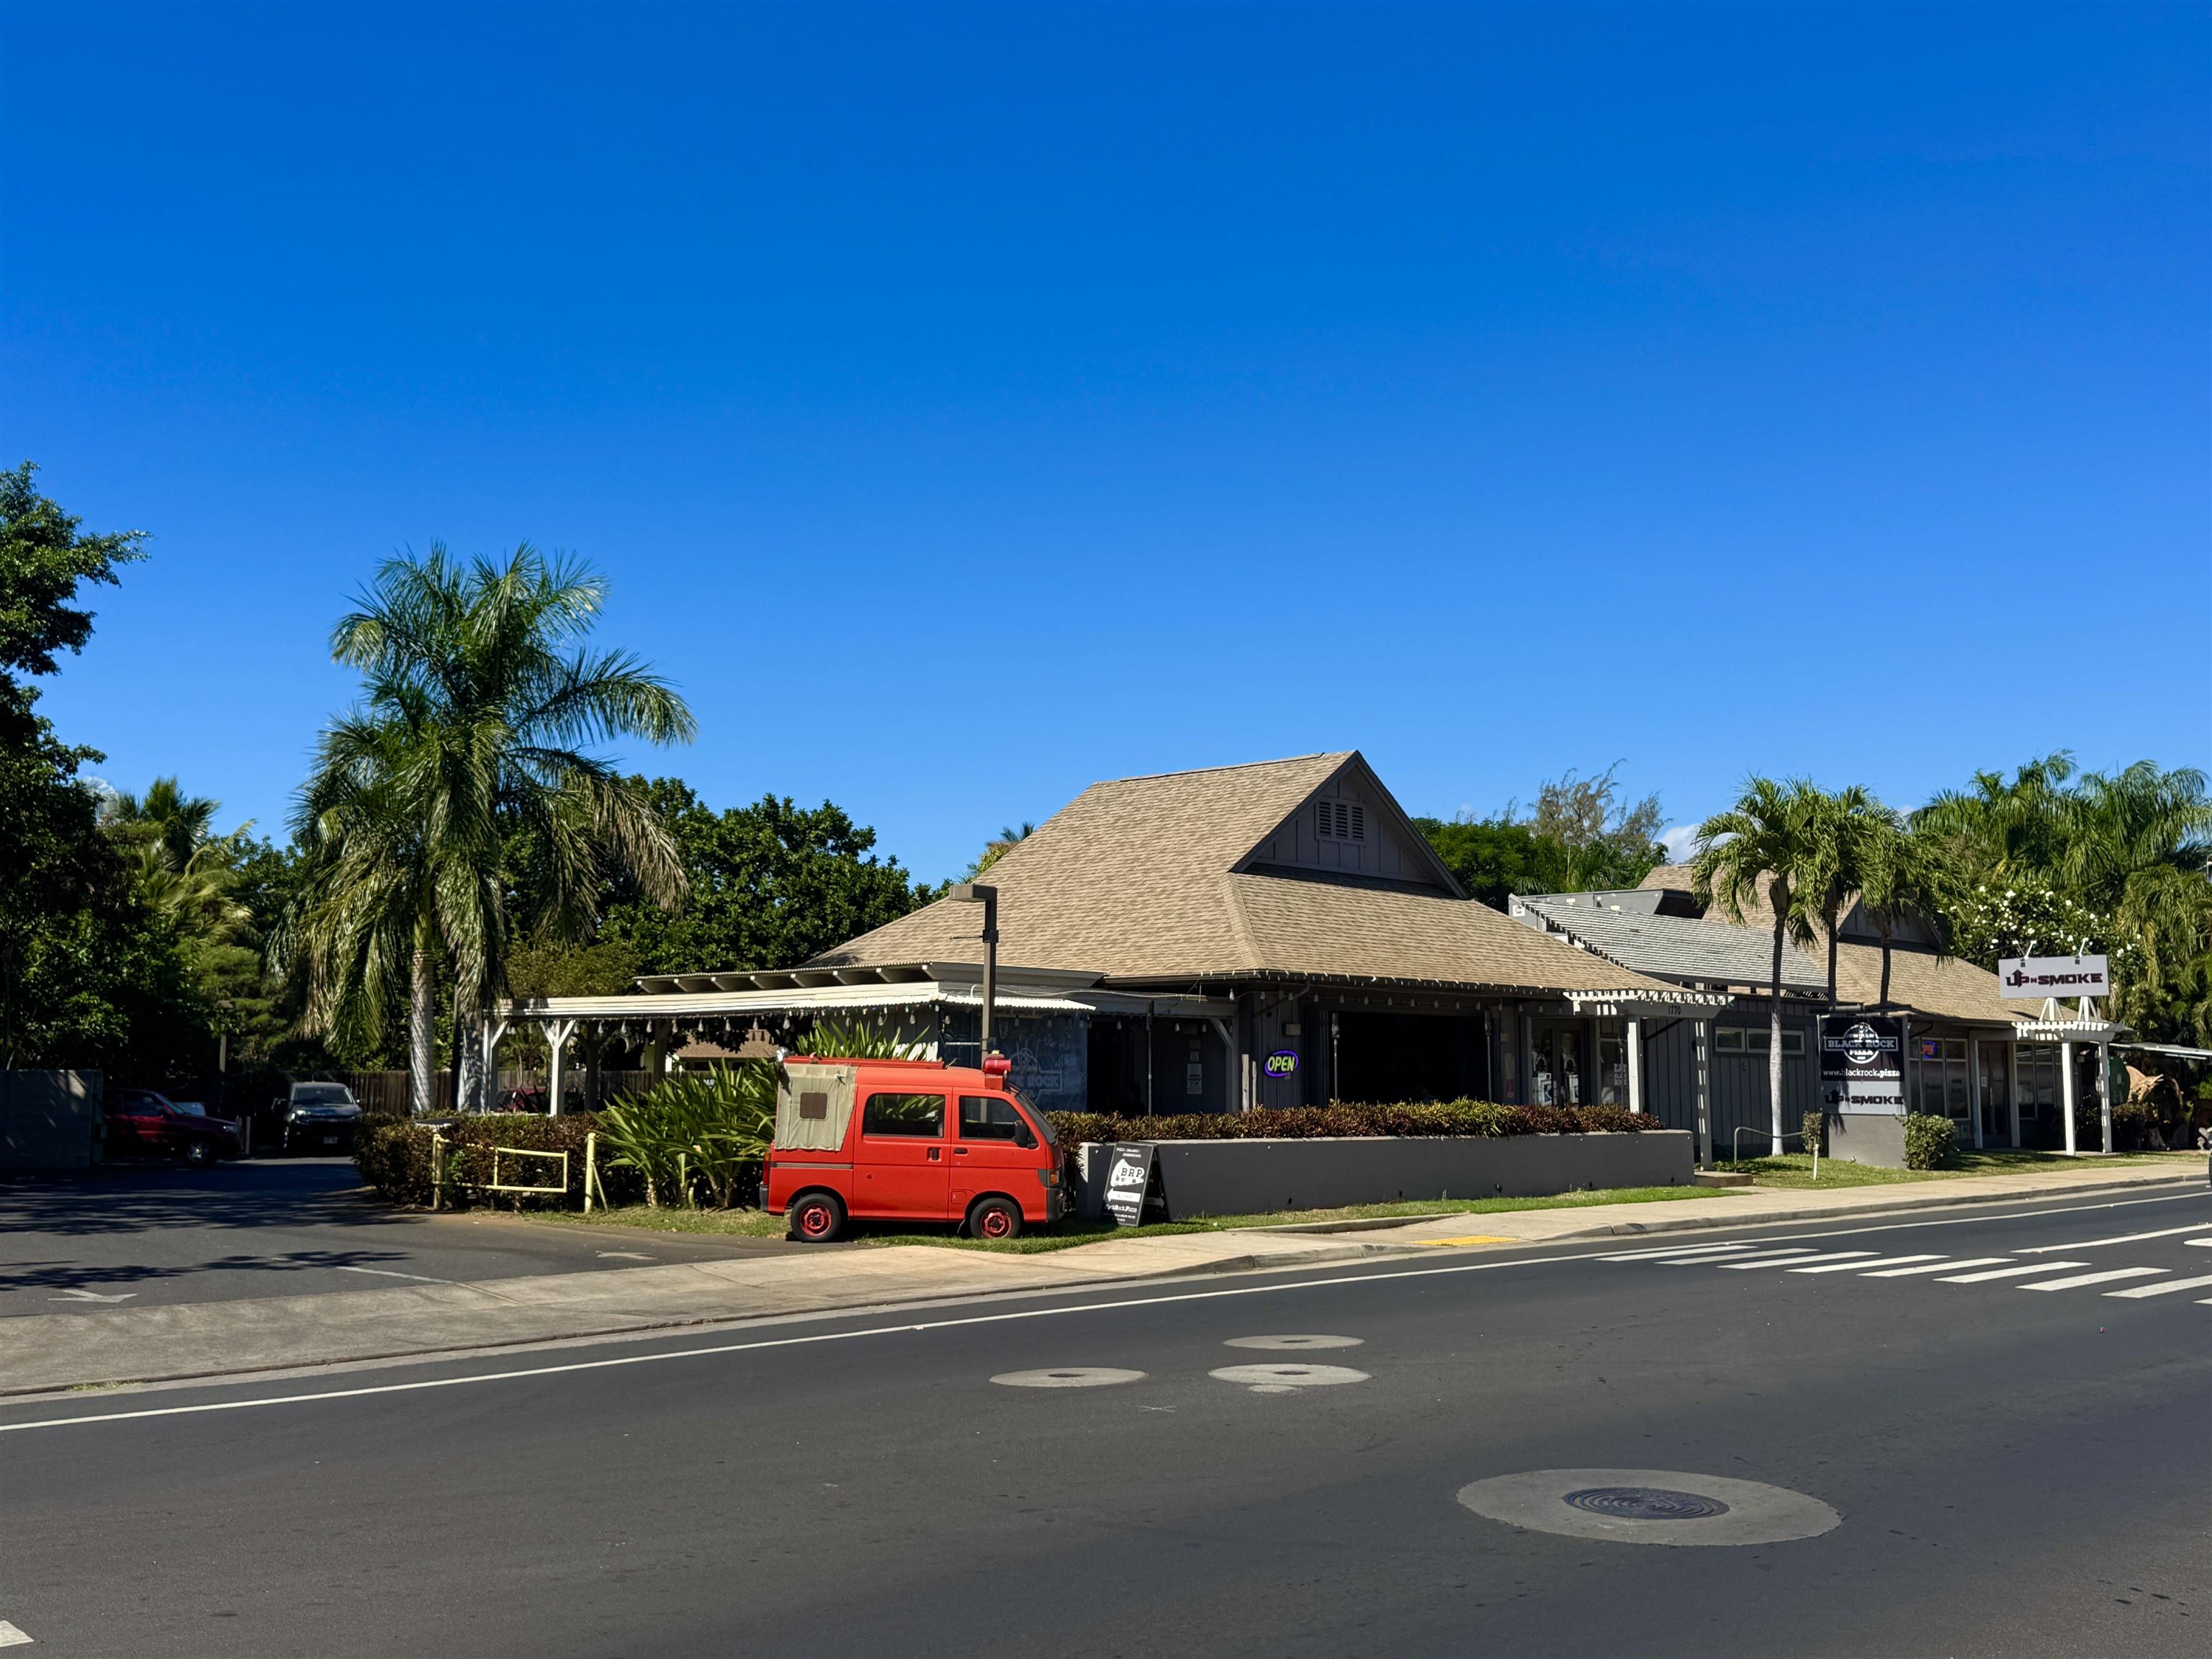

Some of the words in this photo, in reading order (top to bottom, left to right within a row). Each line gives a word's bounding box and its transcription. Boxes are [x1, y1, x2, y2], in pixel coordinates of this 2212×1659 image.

[2005, 969, 2029, 988] UP
[2038, 973, 2103, 987] SMOKE
[1668, 1005, 1681, 1015] 1770
[1267, 1056, 1295, 1072] OPEN
[1822, 1068, 1900, 1079] www.blackrock.pizza
[1851, 1095, 1905, 1106] SMOKE
[1120, 1167, 1143, 1178] BRP
